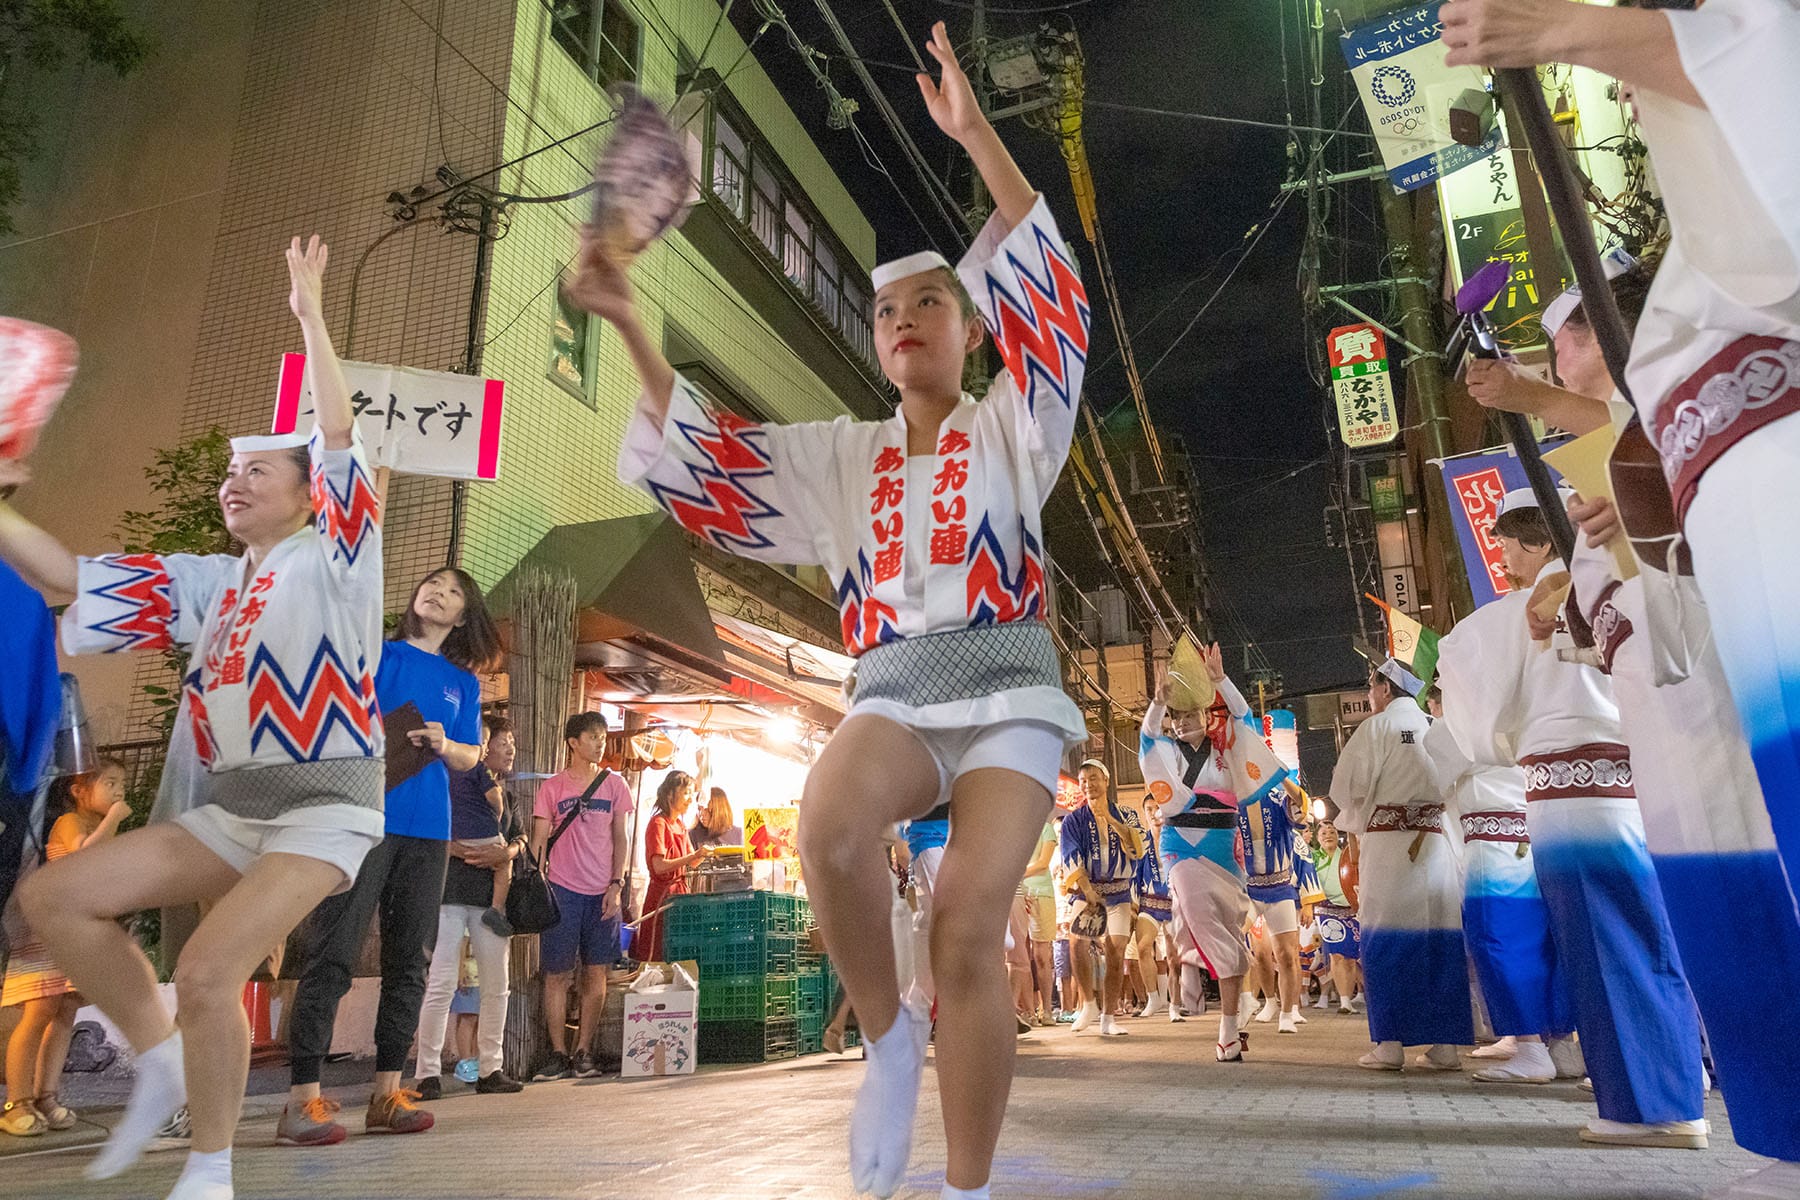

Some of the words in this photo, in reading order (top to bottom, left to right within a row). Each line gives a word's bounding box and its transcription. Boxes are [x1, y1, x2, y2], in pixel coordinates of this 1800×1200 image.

[1488, 154, 1513, 204] ちゃん
[1458, 223, 1483, 240] 2F
[1334, 328, 1378, 364] 質
[301, 390, 473, 441] タートです
[1351, 378, 1379, 426] なかや
[870, 446, 905, 586] あおい連
[930, 428, 971, 565] あおい連
[1394, 574, 1408, 608] POLA
